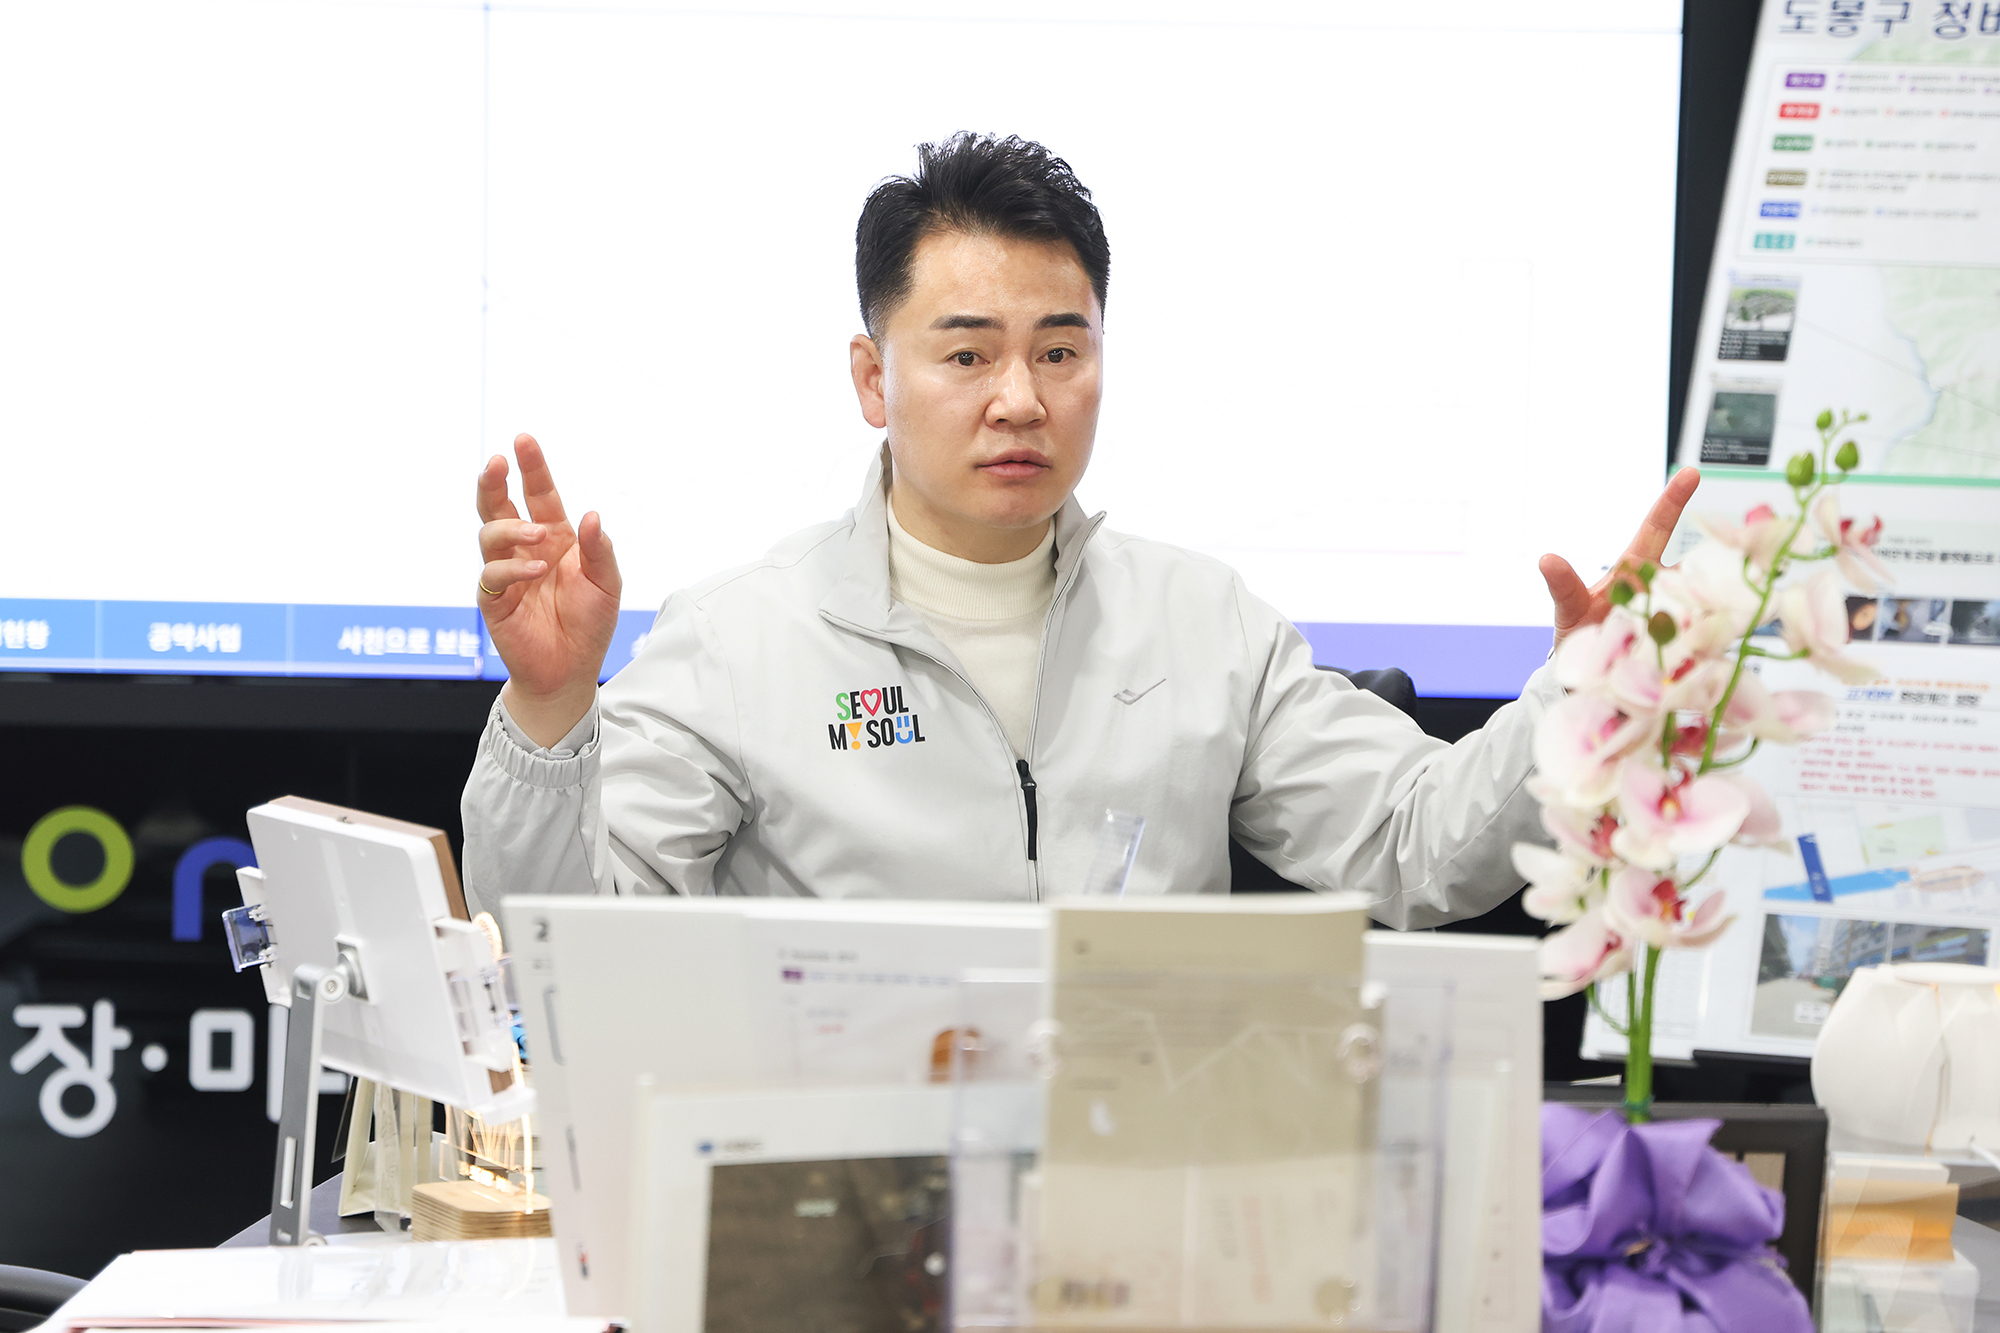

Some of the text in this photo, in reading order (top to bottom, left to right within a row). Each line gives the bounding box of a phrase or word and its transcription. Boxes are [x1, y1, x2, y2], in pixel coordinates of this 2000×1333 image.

[1778, 0, 1910, 37] 도봉구
[0, 618, 50, 650] 현황
[148, 621, 242, 653] 공약사업
[338, 626, 431, 656] 사진으로
[434, 628, 482, 657] 보는
[866, 714, 926, 748] SOUL
[10, 998, 348, 1138] 장·미
